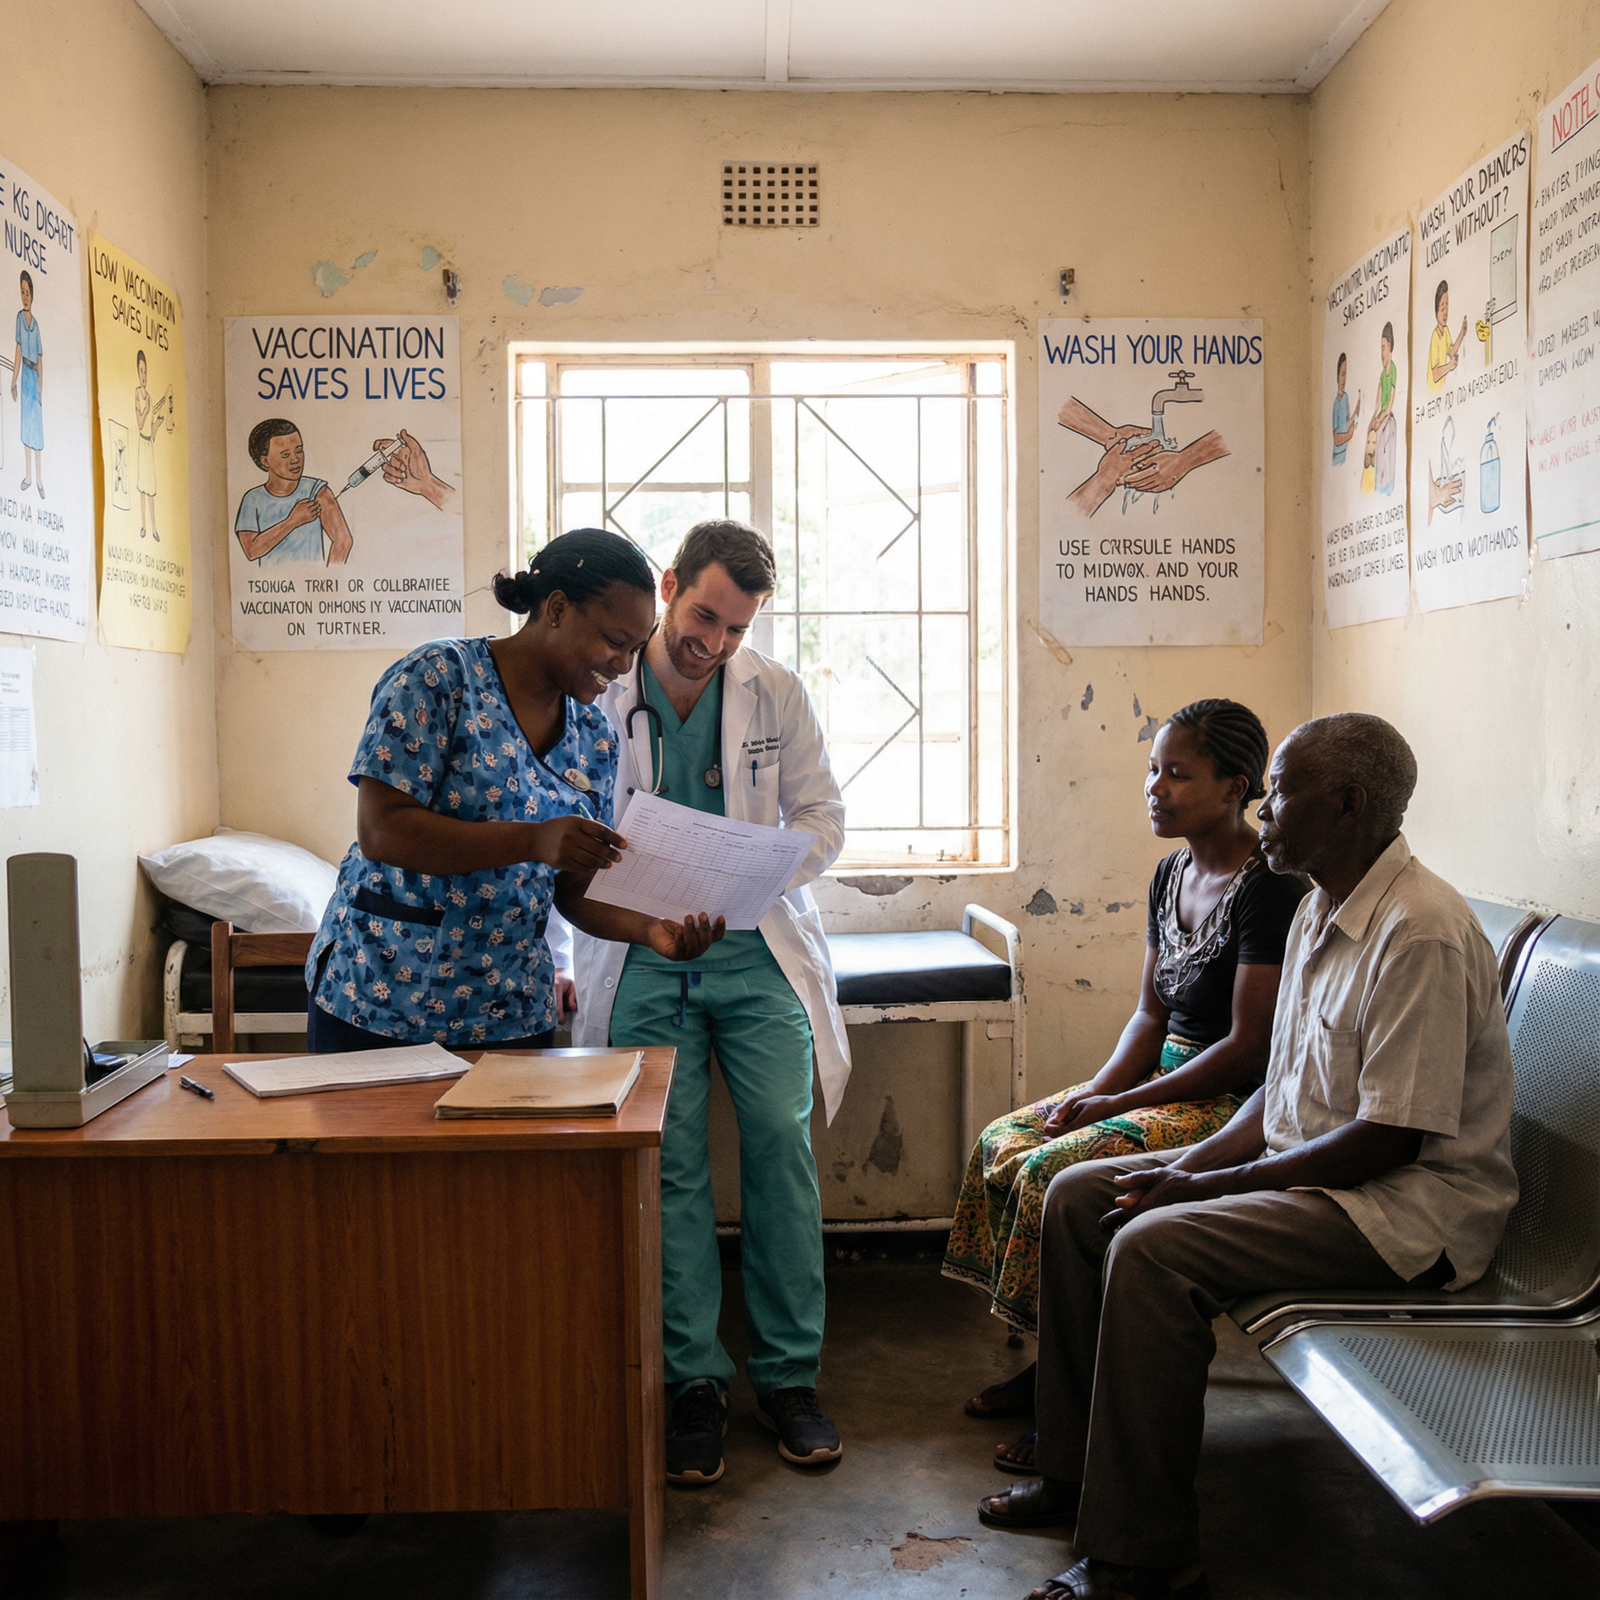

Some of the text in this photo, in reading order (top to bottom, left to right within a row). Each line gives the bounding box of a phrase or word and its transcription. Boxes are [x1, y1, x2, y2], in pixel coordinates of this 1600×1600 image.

[12, 181, 30, 222] KG
[1419, 200, 1446, 241] WASH
[1448, 177, 1476, 217] YOUR
[4, 218, 48, 276] NURSE
[93, 246, 118, 285] LOW
[111, 293, 170, 352] SAVES LIVES
[252, 326, 444, 360] VACCINATION
[1043, 334, 1263, 365] WASH YOUR HANDS
[257, 367, 447, 400] SAVES LIVES
[1059, 539, 1091, 556] USE
[1182, 537, 1237, 555] HANDS
[347, 579, 365, 593] OR
[1055, 563, 1075, 579] TO
[1156, 562, 1189, 578] AND
[1197, 562, 1240, 579] YOUR
[240, 600, 313, 615] VACCINATON
[388, 599, 462, 614] VACCINATION
[1085, 585, 1210, 603] HANDS HANDS.
[287, 621, 386, 636] ON TURTNER.
